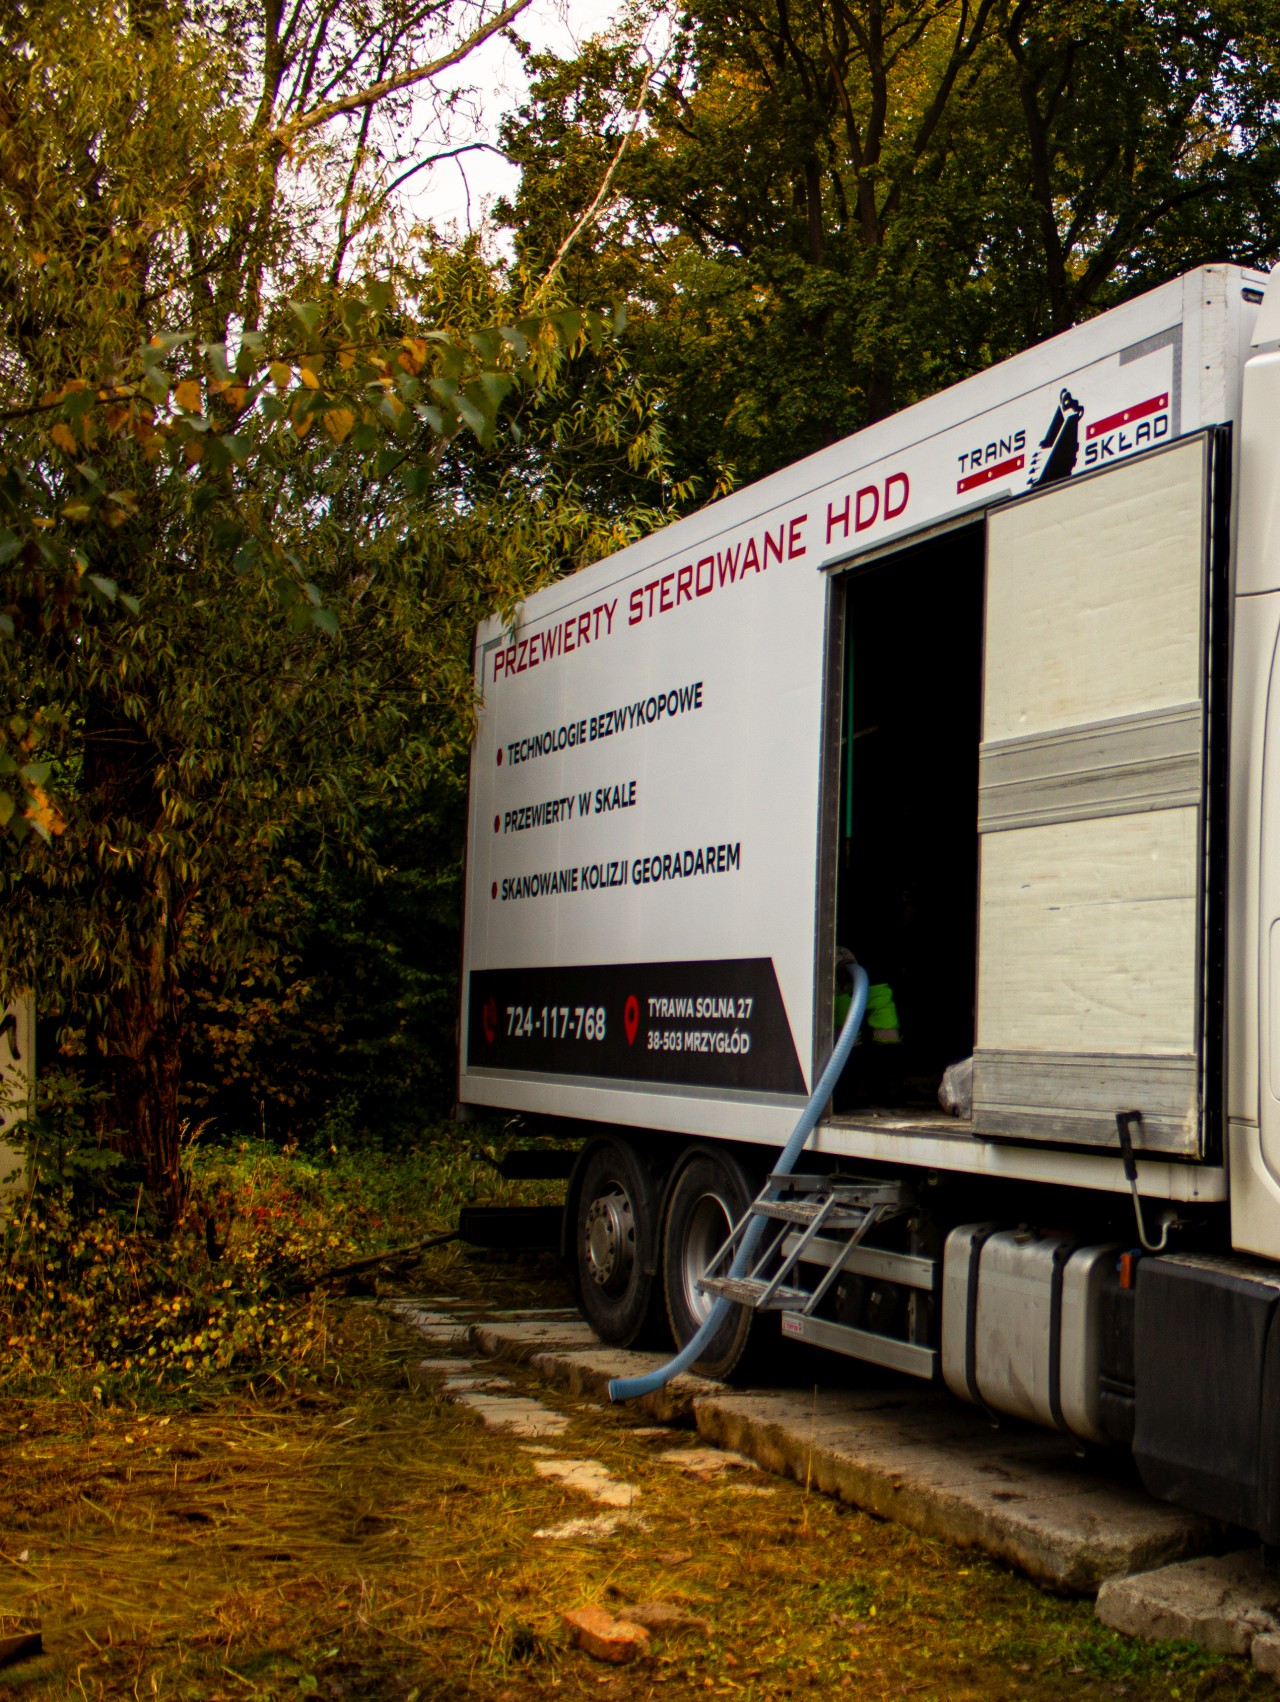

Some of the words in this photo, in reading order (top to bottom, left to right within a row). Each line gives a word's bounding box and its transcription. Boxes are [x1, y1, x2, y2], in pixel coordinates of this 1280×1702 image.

[957, 429, 1026, 474] TRANS
[1084, 414, 1169, 466] SKŁAD
[493, 598, 618, 683] PRZEWIERTY
[628, 513, 808, 626] STEROWANE
[826, 471, 910, 545] HDD
[508, 719, 587, 766] TECHNOLOGIE
[589, 681, 704, 742] BEZWYKOPOWE
[504, 796, 575, 834] PRZEWIERTY
[578, 791, 592, 817] W
[595, 780, 637, 814] SKALE
[501, 868, 579, 901] SKANOWANIE
[581, 860, 629, 890] KOLIZJI
[632, 842, 741, 886] GEORADAREM
[506, 1006, 606, 1041] 724-117-768
[648, 998, 694, 1019] TYRAWA
[695, 999, 735, 1019] SOLNA
[736, 998, 753, 1019] 27
[647, 1031, 682, 1051] 38-503
[684, 1028, 750, 1054] MRZYGŁÓD
